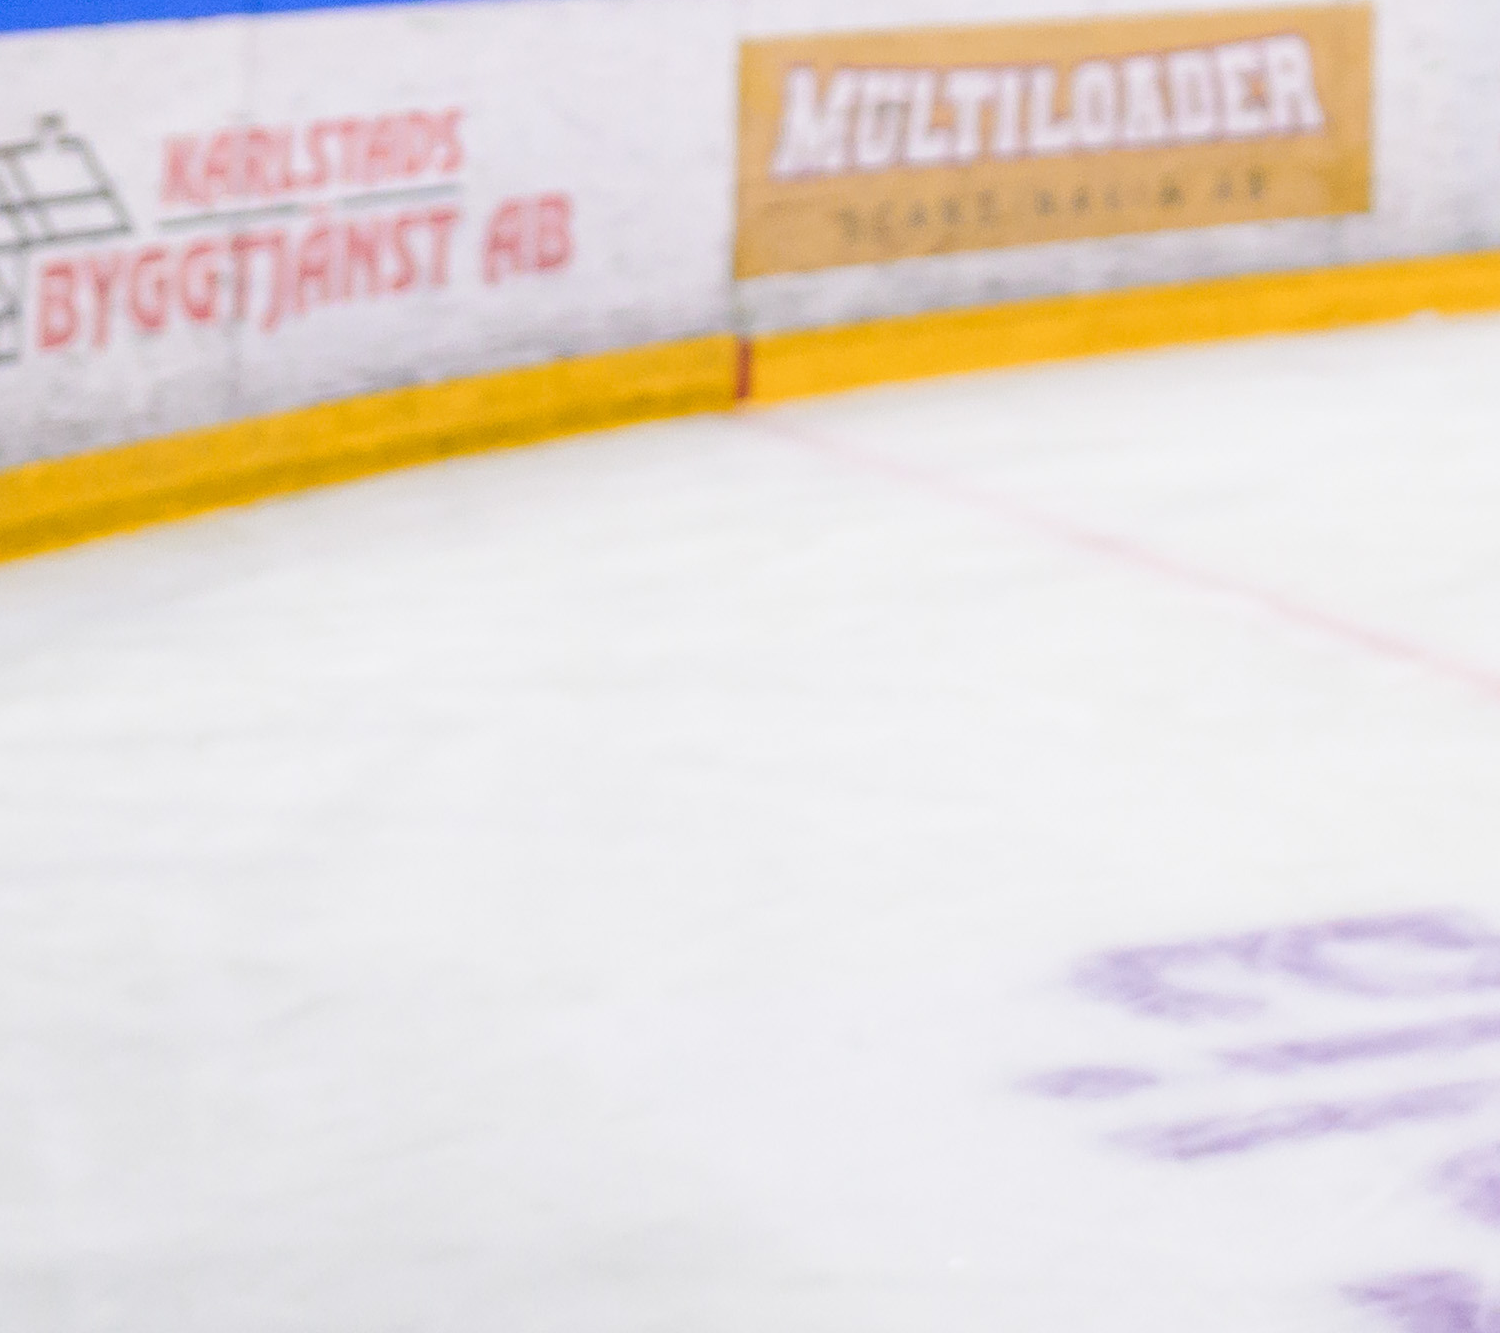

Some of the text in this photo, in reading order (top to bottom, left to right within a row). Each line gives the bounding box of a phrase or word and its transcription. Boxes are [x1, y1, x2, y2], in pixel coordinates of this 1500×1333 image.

[160, 107, 466, 207] KARLSTADS
[768, 31, 1326, 183] MULTILOADER
[35, 191, 576, 352] BYGGTJÄNST AB
